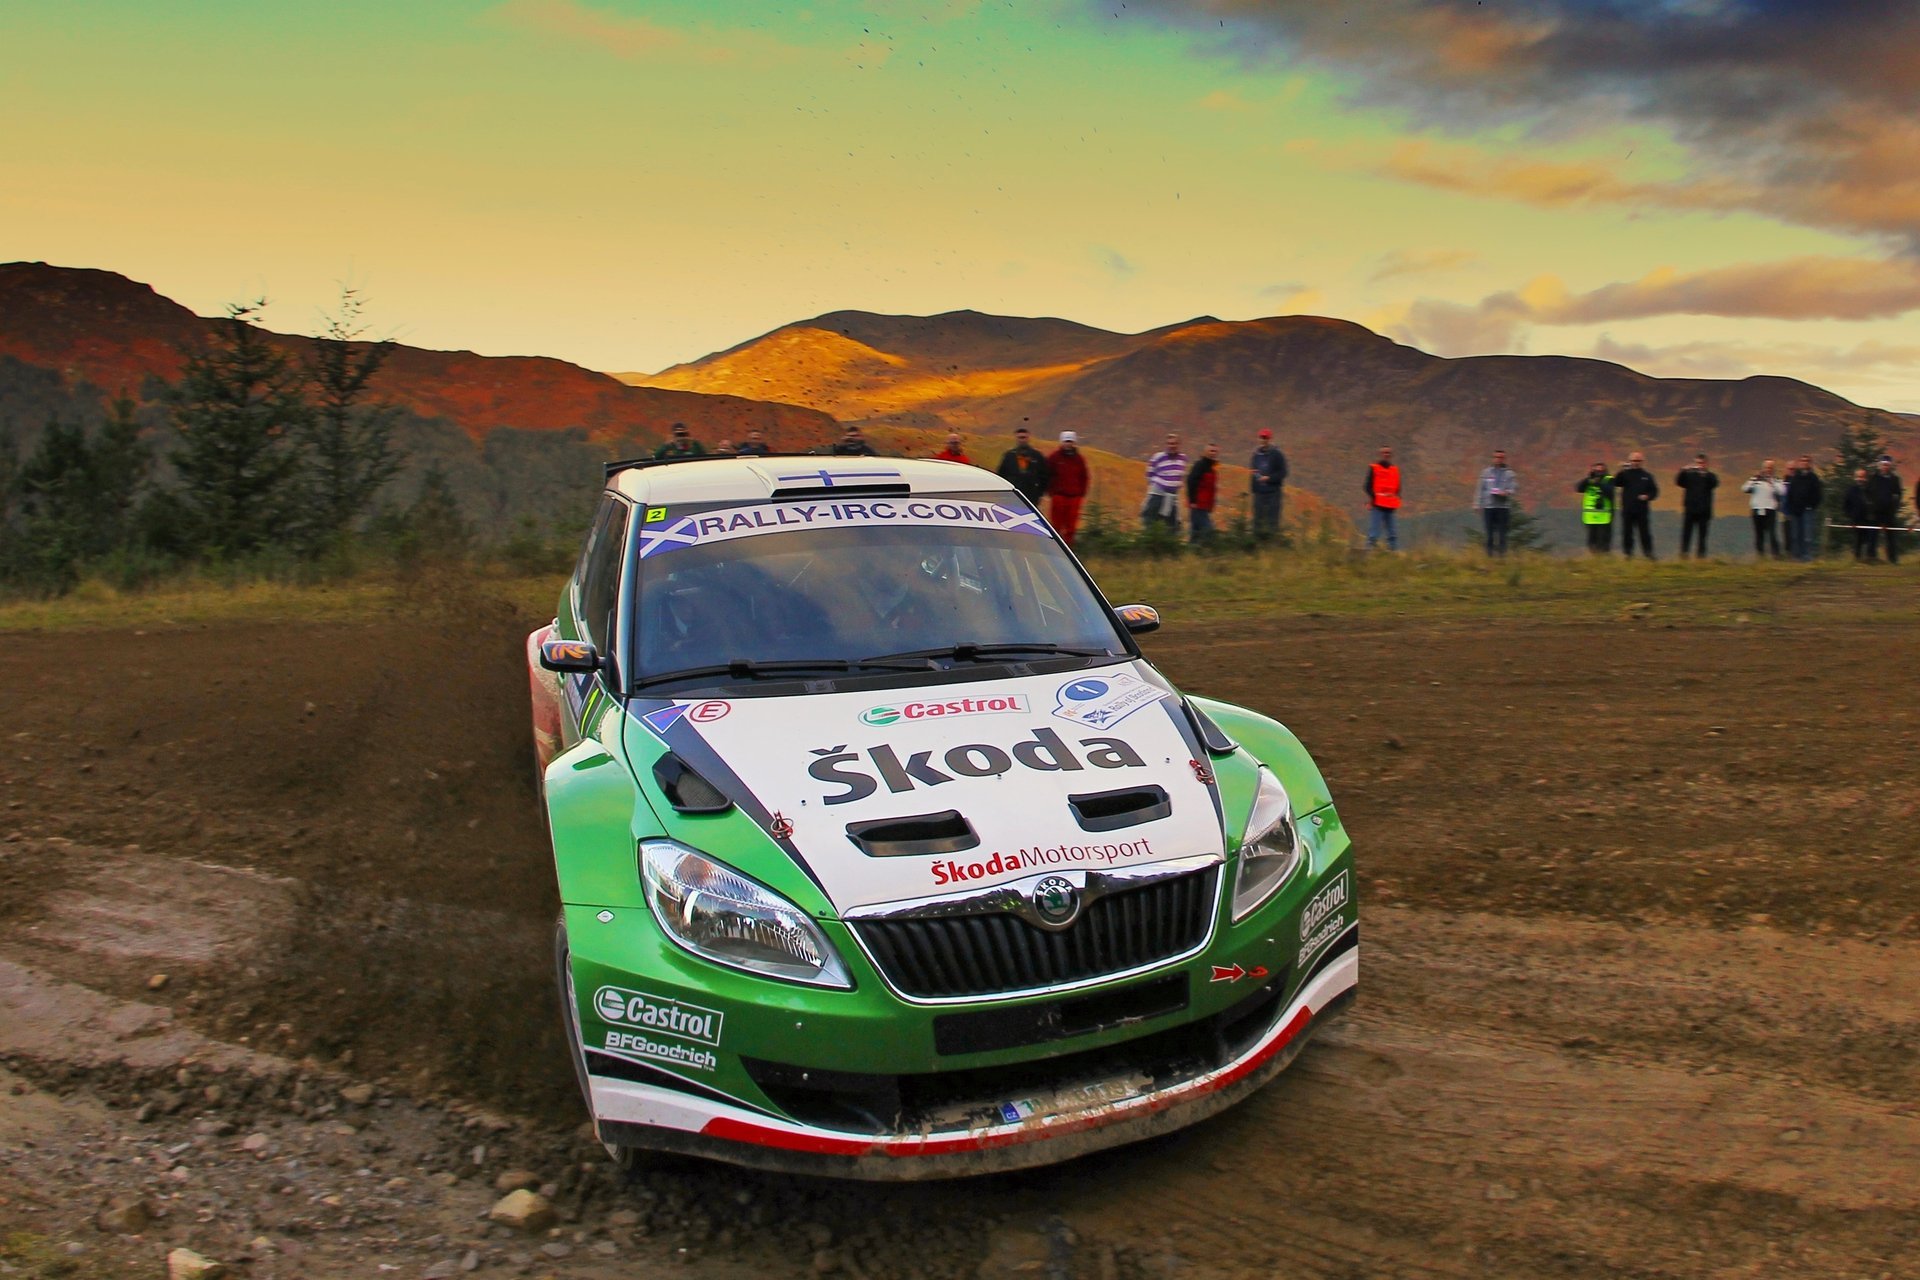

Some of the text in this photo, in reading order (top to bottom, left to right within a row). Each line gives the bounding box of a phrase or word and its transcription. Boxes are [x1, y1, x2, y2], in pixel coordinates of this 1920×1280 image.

[651, 511, 662, 520] 2
[699, 503, 995, 536] RALLY-IRC.COM
[1075, 685, 1099, 694] 1
[698, 704, 723, 718] E
[904, 697, 1022, 718] Castrol
[808, 727, 1147, 805] Škoda
[1310, 878, 1345, 927] Castrol
[627, 997, 713, 1039] Castrol
[605, 1031, 716, 1067] BFGoodrich
[1006, 1112, 1018, 1120] CZ
